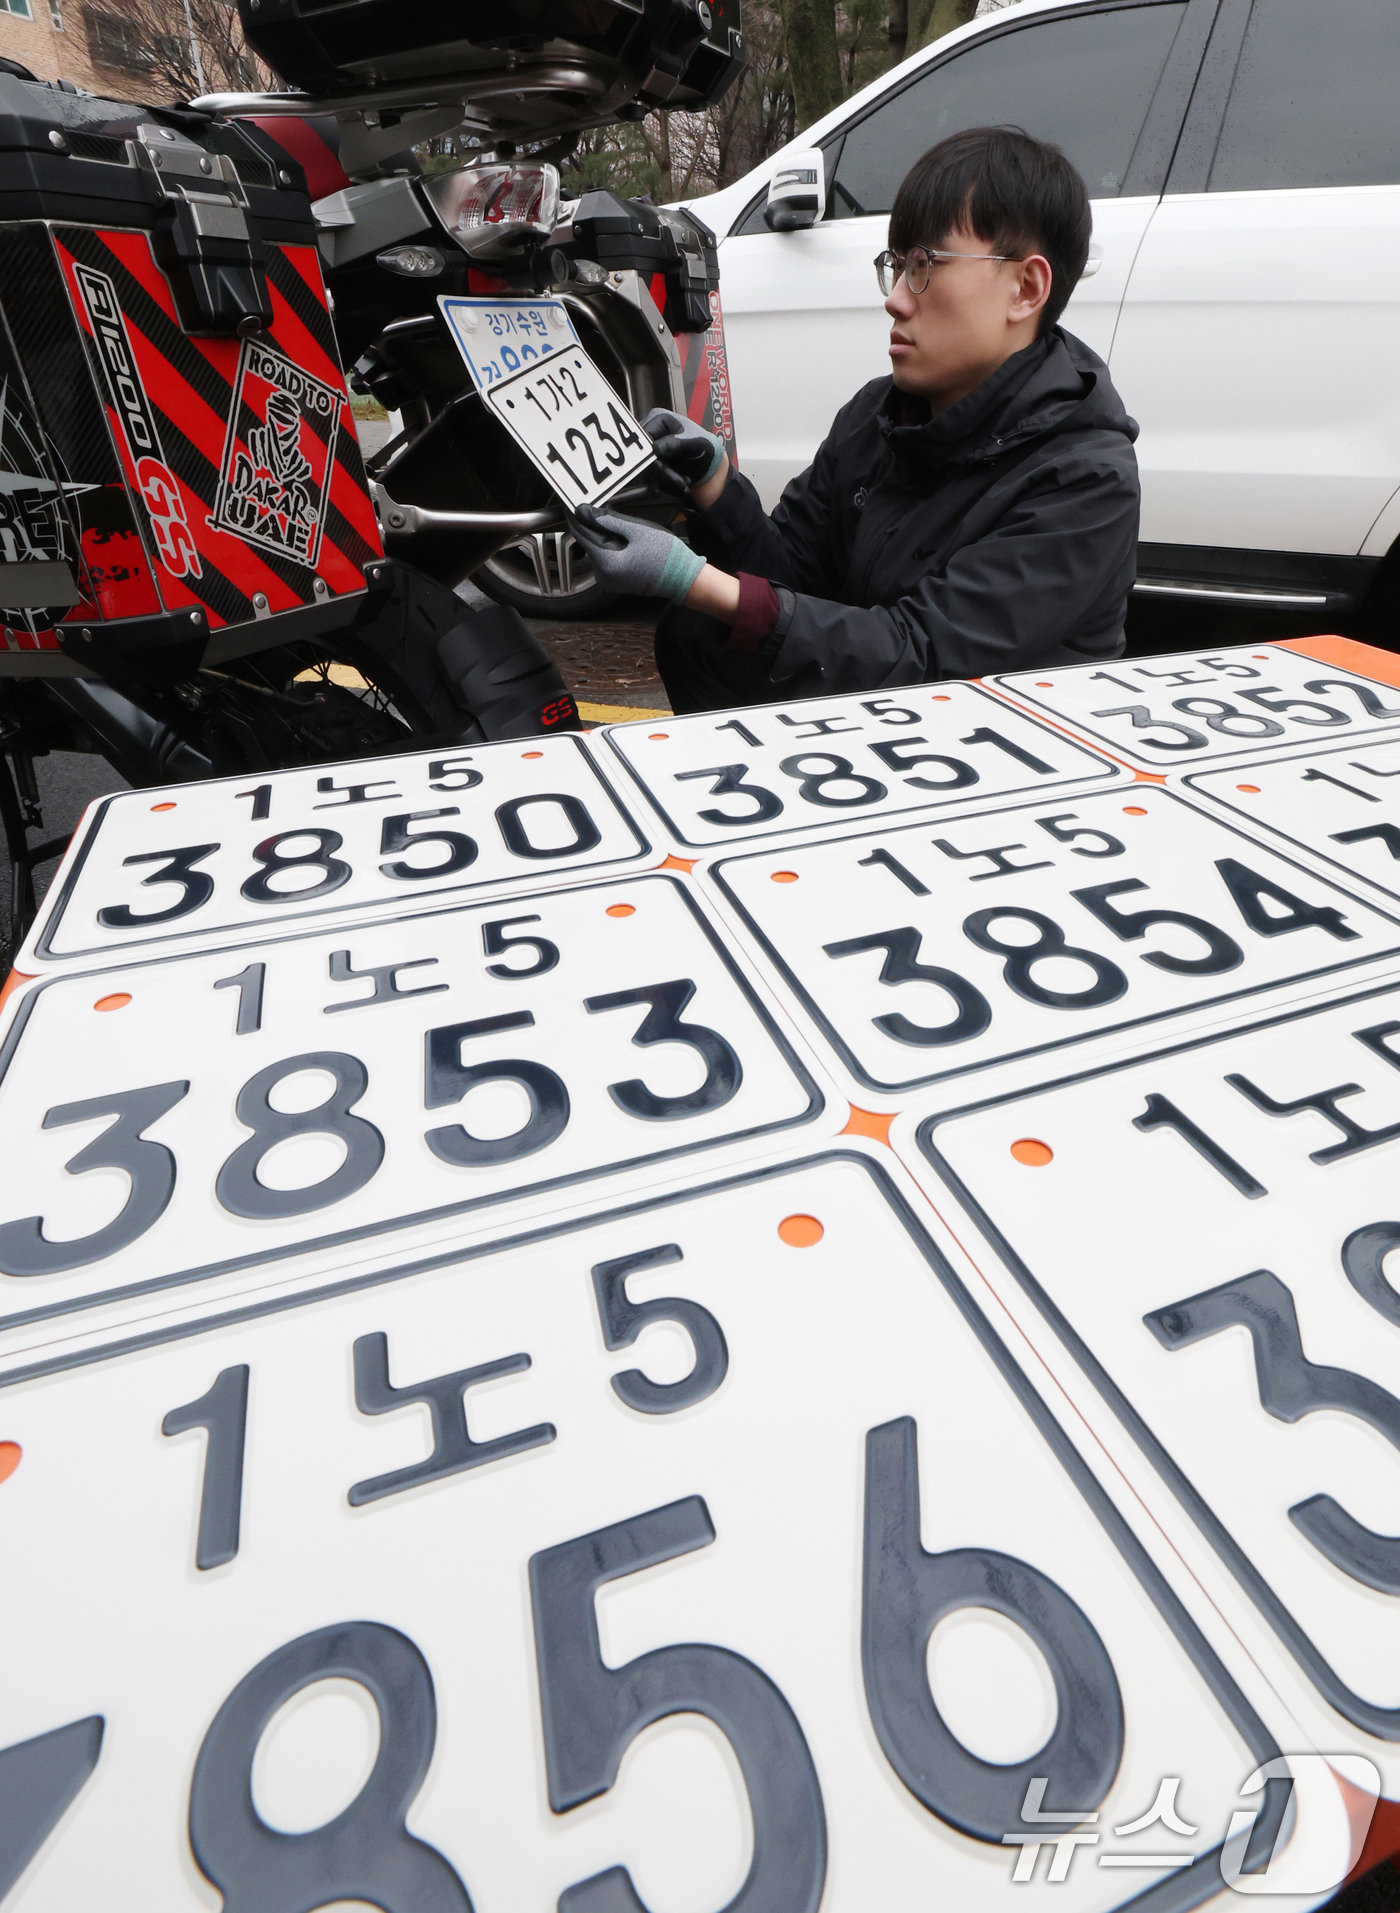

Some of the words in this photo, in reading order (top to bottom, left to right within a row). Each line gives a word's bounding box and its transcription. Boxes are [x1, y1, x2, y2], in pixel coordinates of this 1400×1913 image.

[708, 290, 723, 346] ONE
[248, 348, 301, 396] ROAD
[304, 381, 331, 413] TO
[524, 366, 588, 421] 1가2
[714, 348, 732, 441] WORLD
[236, 453, 310, 528] DAKAR
[546, 402, 643, 495] 1234
[137, 456, 202, 578] GS
[227, 496, 310, 555] UAE
[541, 697, 573, 726] GS
[1091, 679, 1400, 751] 3852
[674, 727, 1060, 826] 3851
[97, 793, 602, 929] 3850
[822, 858, 1363, 1048] 3854
[0, 978, 743, 1278] 3853
[0, 1415, 1125, 1913] 856
